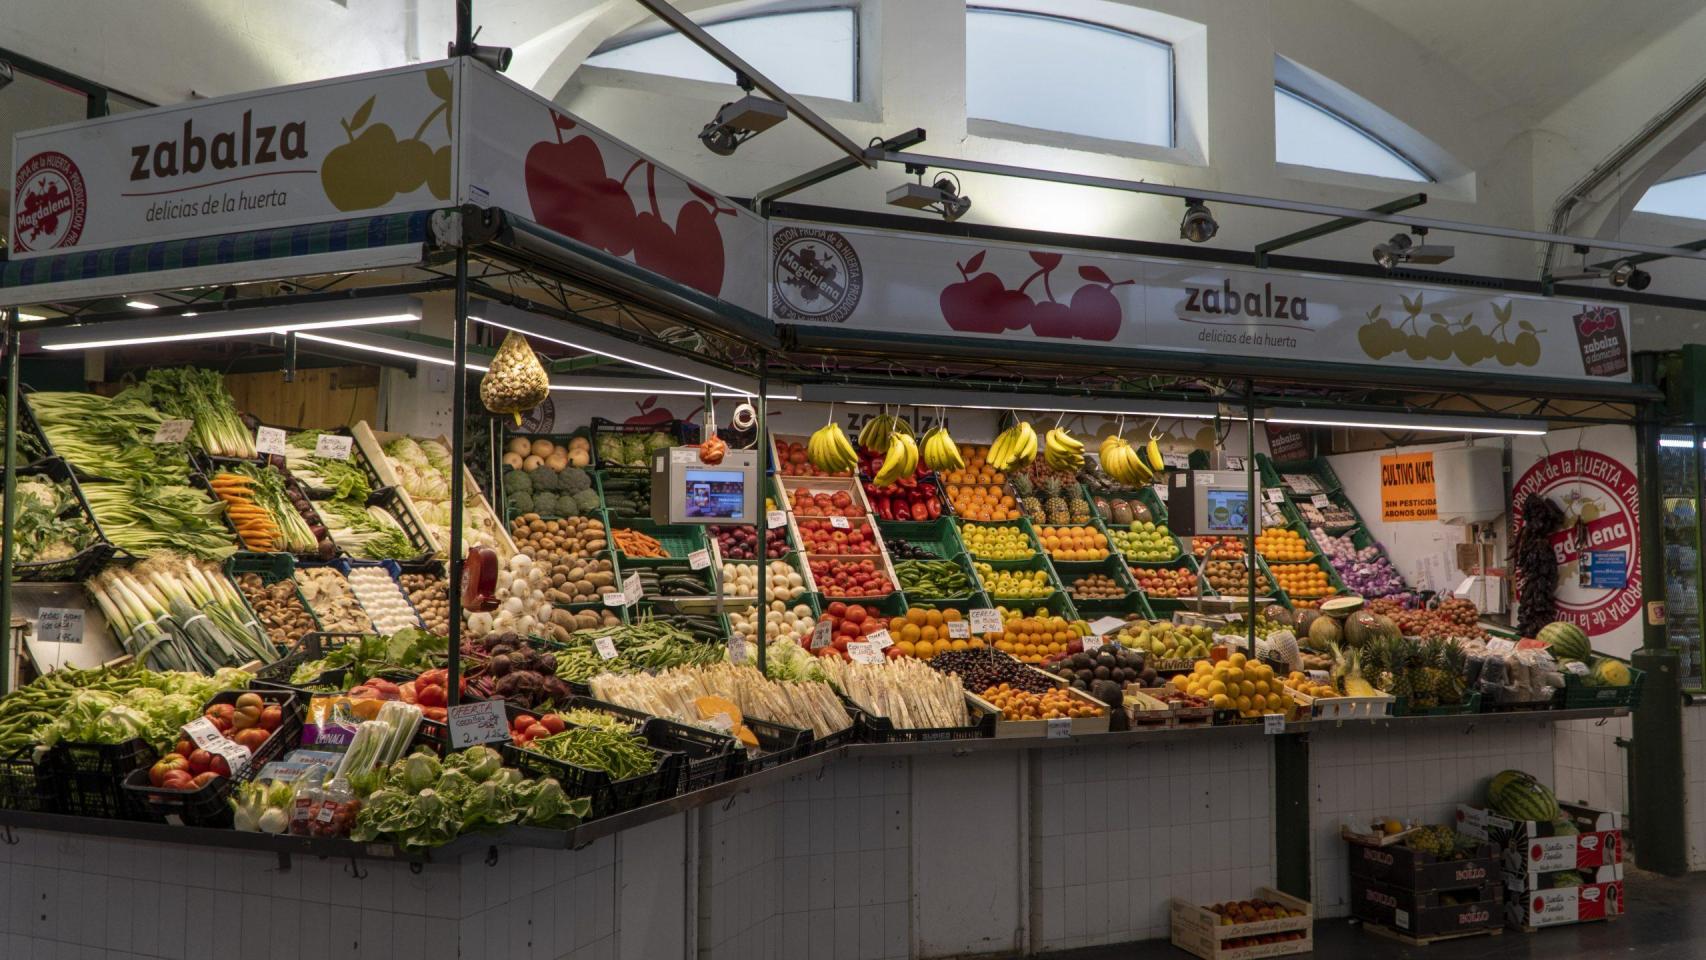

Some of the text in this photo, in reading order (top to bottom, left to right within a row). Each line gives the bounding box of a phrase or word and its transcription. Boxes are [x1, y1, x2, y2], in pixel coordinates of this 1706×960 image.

[130, 108, 308, 181] zabalza
[17, 195, 71, 229] Magdalena
[145, 188, 288, 222] delicias de la huerta
[782, 252, 840, 300] Magdalena
[1184, 278, 1310, 321] zabalza
[1198, 328, 1297, 348] delicias de la huerta
[1584, 335, 1619, 354] zabalza
[1383, 462, 1414, 486] CULTIVO
[1545, 462, 1560, 480] de
[1560, 457, 1571, 474] la
[1575, 455, 1623, 488] HUERTA
[1385, 500, 1398, 508] SIN
[1385, 509, 1415, 518] ABONOS
[451, 701, 493, 719] OFERTA
[1455, 868, 1487, 881] BOLLO
[1458, 910, 1490, 924] BOLLO
